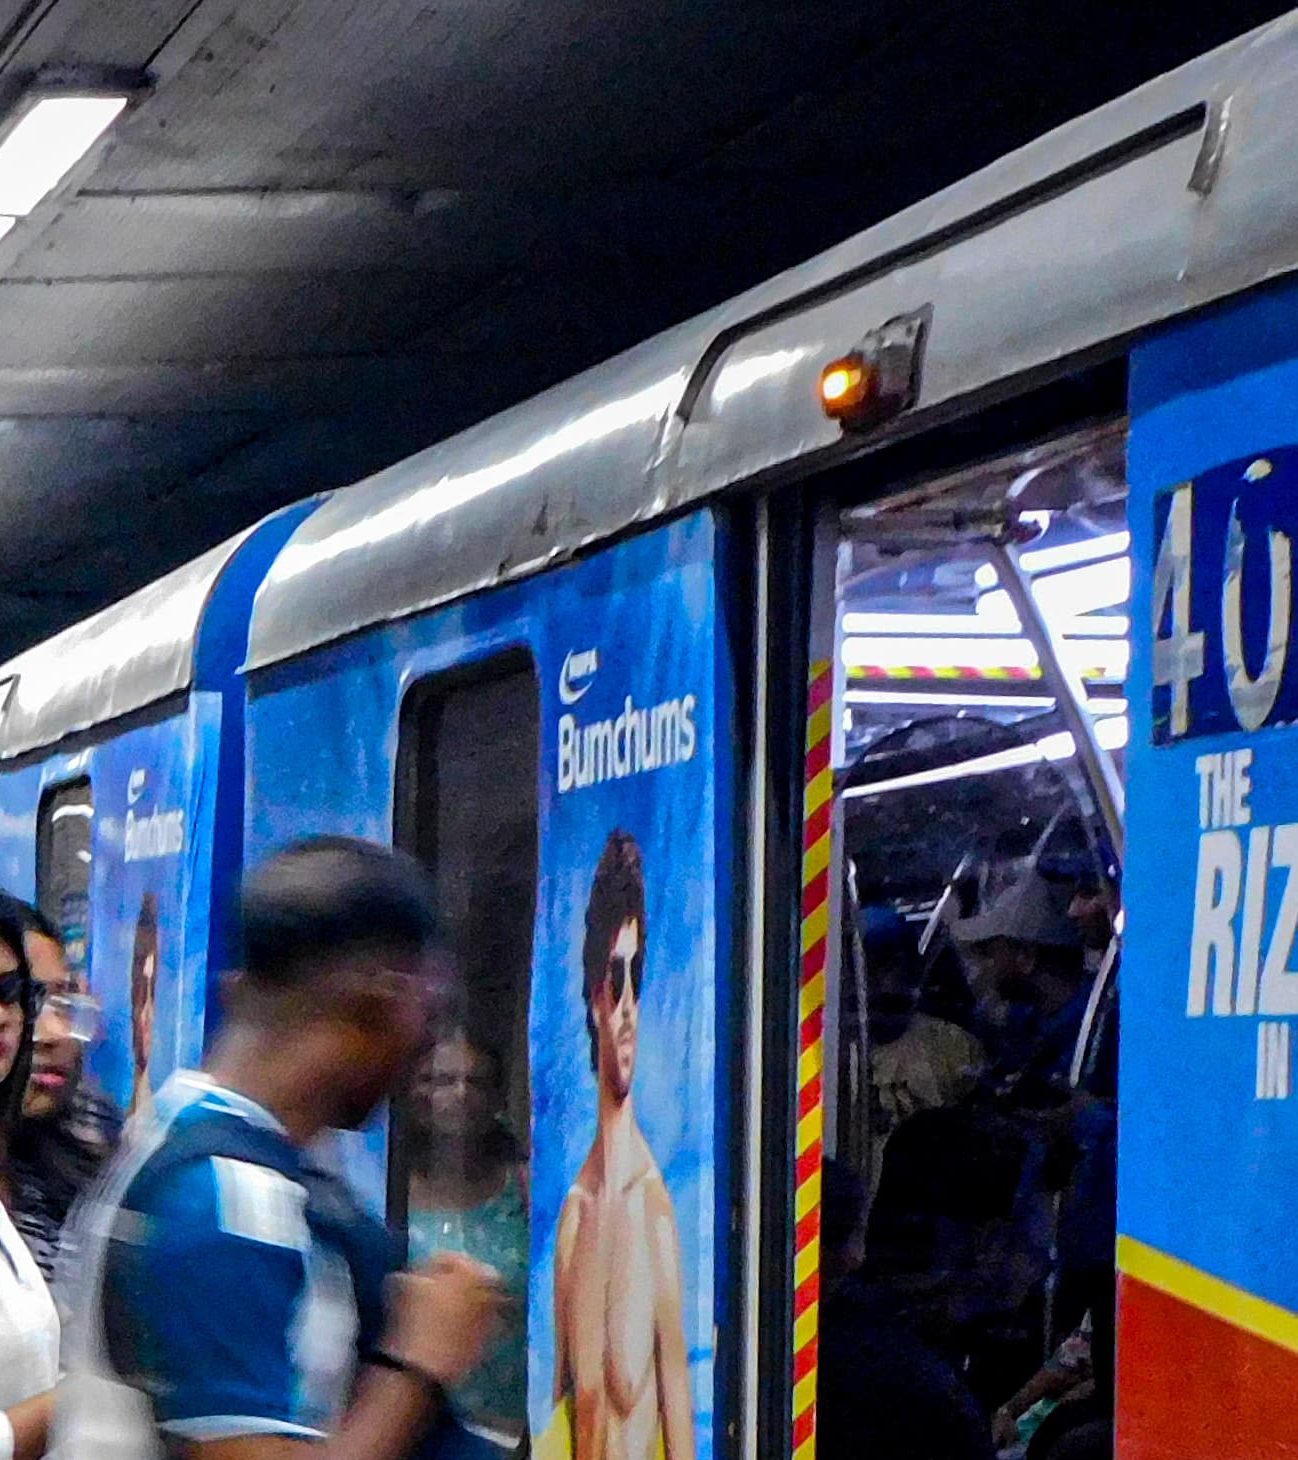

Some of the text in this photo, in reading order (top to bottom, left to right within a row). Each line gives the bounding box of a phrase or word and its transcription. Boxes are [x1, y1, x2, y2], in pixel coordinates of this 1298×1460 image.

[557, 693, 697, 794] Bumchums
[1195, 748, 1252, 829] THE
[1255, 1020, 1290, 1100] IN
